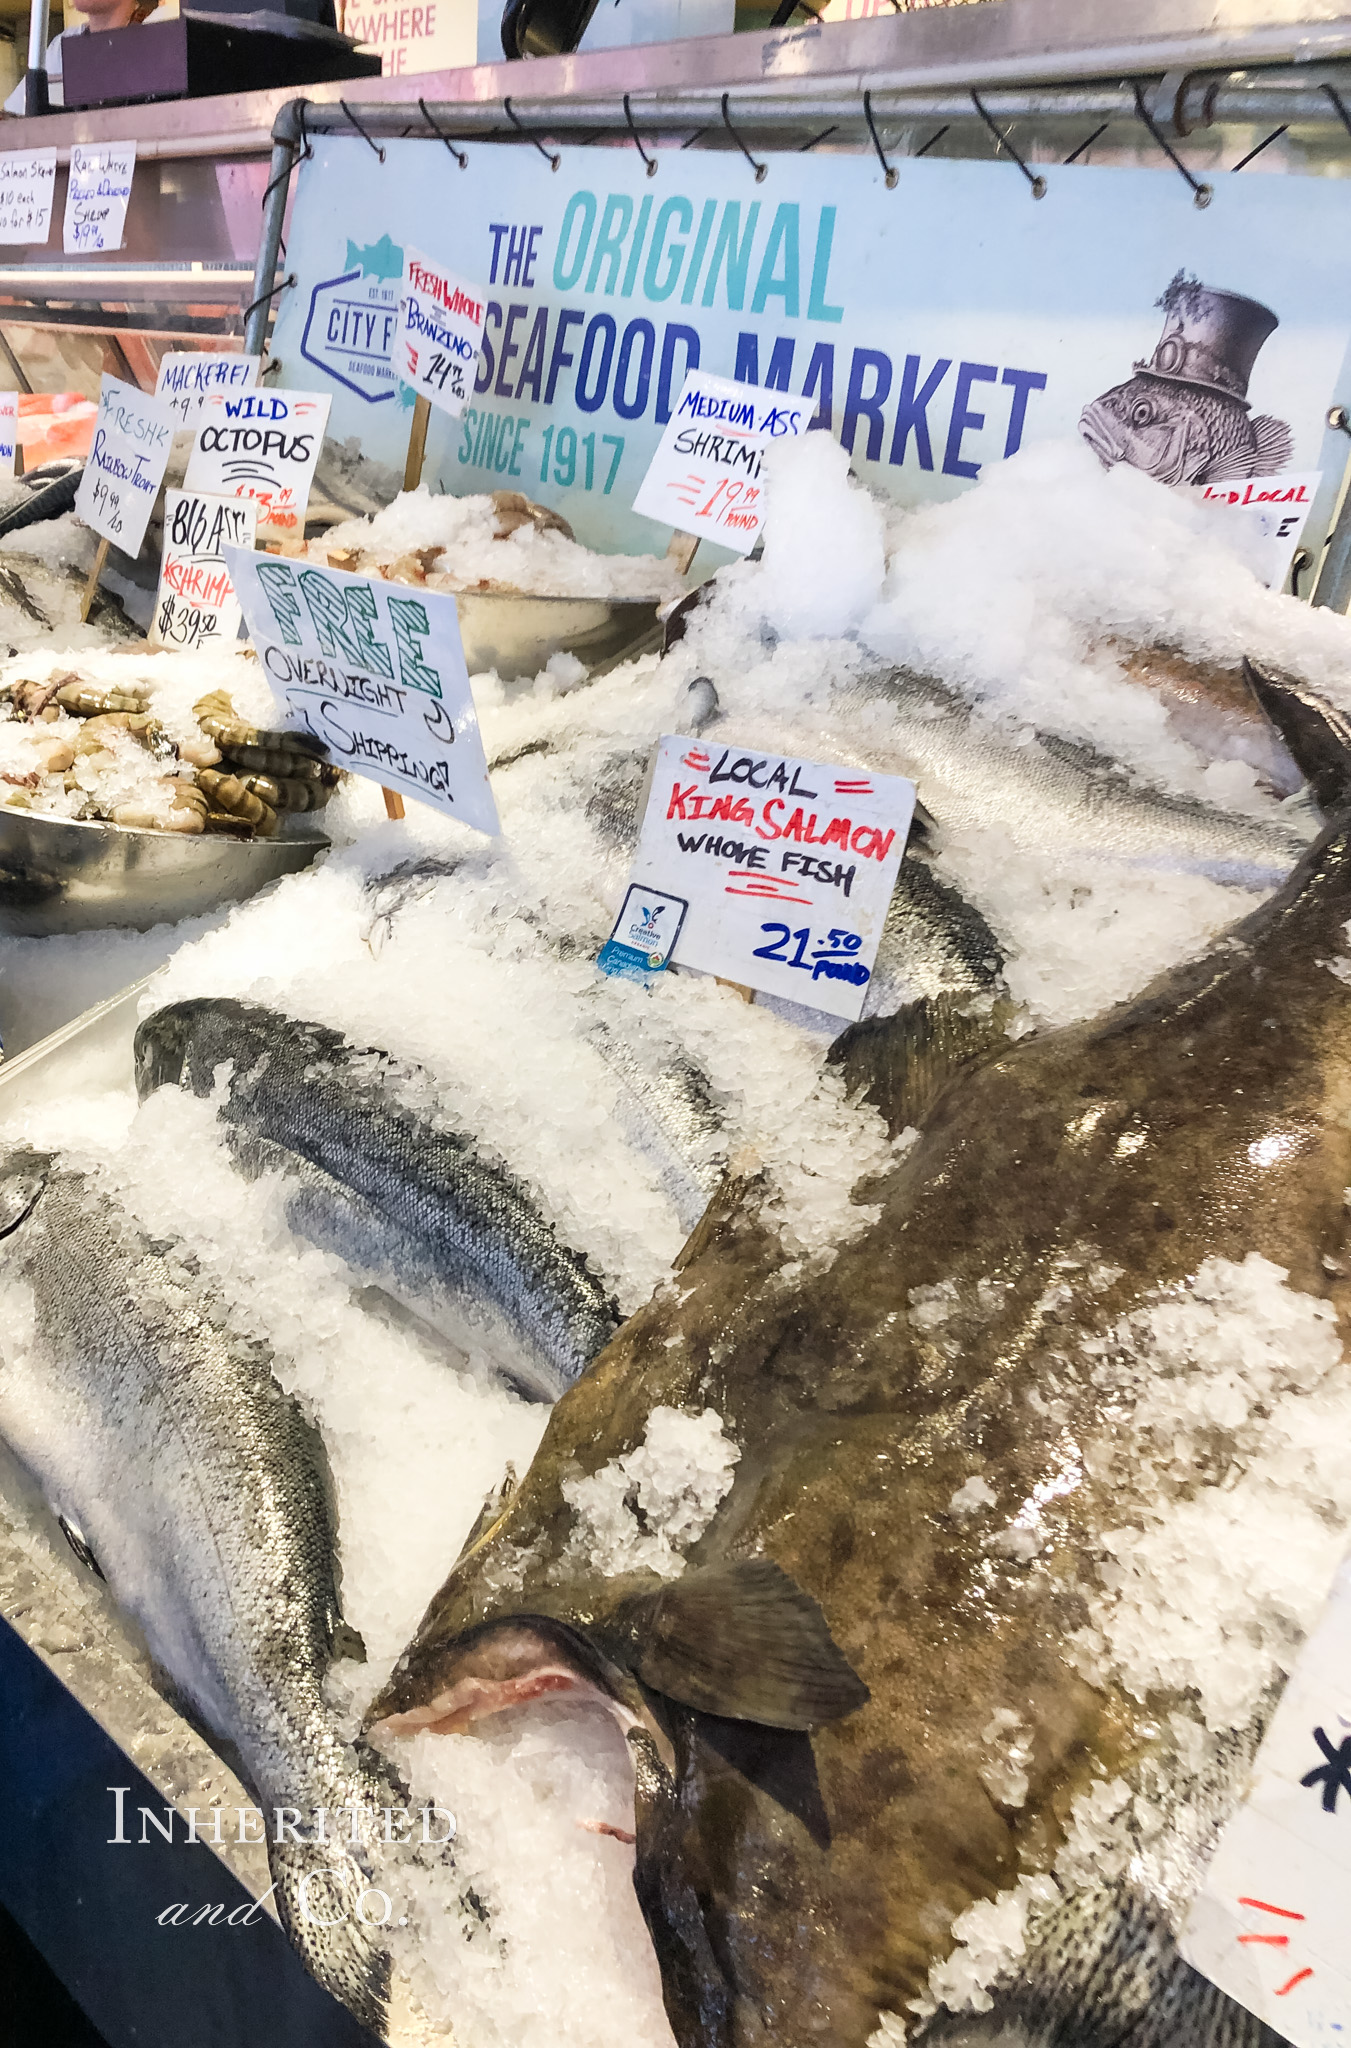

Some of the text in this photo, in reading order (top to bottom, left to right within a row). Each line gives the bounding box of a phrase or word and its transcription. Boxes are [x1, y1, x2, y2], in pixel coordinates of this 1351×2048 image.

[348, 5, 436, 43] YWHERE
[382, 48, 407, 76] HE
[489, 190, 844, 323] THE ORIGINAL
[409, 261, 484, 327] FRESH WHOLE
[327, 307, 377, 349] CITY
[405, 297, 473, 360] BRANZINO
[348, 360, 399, 380] SEAFOOD MARKE
[473, 301, 700, 426] SEAFOOD
[225, 396, 288, 421] WILD
[200, 426, 315, 463] OCTOPUS
[458, 407, 626, 496] SINCE 1917
[1241, 484, 1309, 505] LOCAL
[172, 498, 207, 556] BIG
[724, 513, 759, 530] POUND
[256, 562, 443, 699] FREE
[264, 645, 408, 714] OVERNIGHT
[709, 750, 819, 800] LOCAL
[666, 782, 896, 862] KING SALMON
[781, 851, 857, 898] FISH
[611, 946, 644, 964] Premium
[630, 923, 661, 941] Creative
